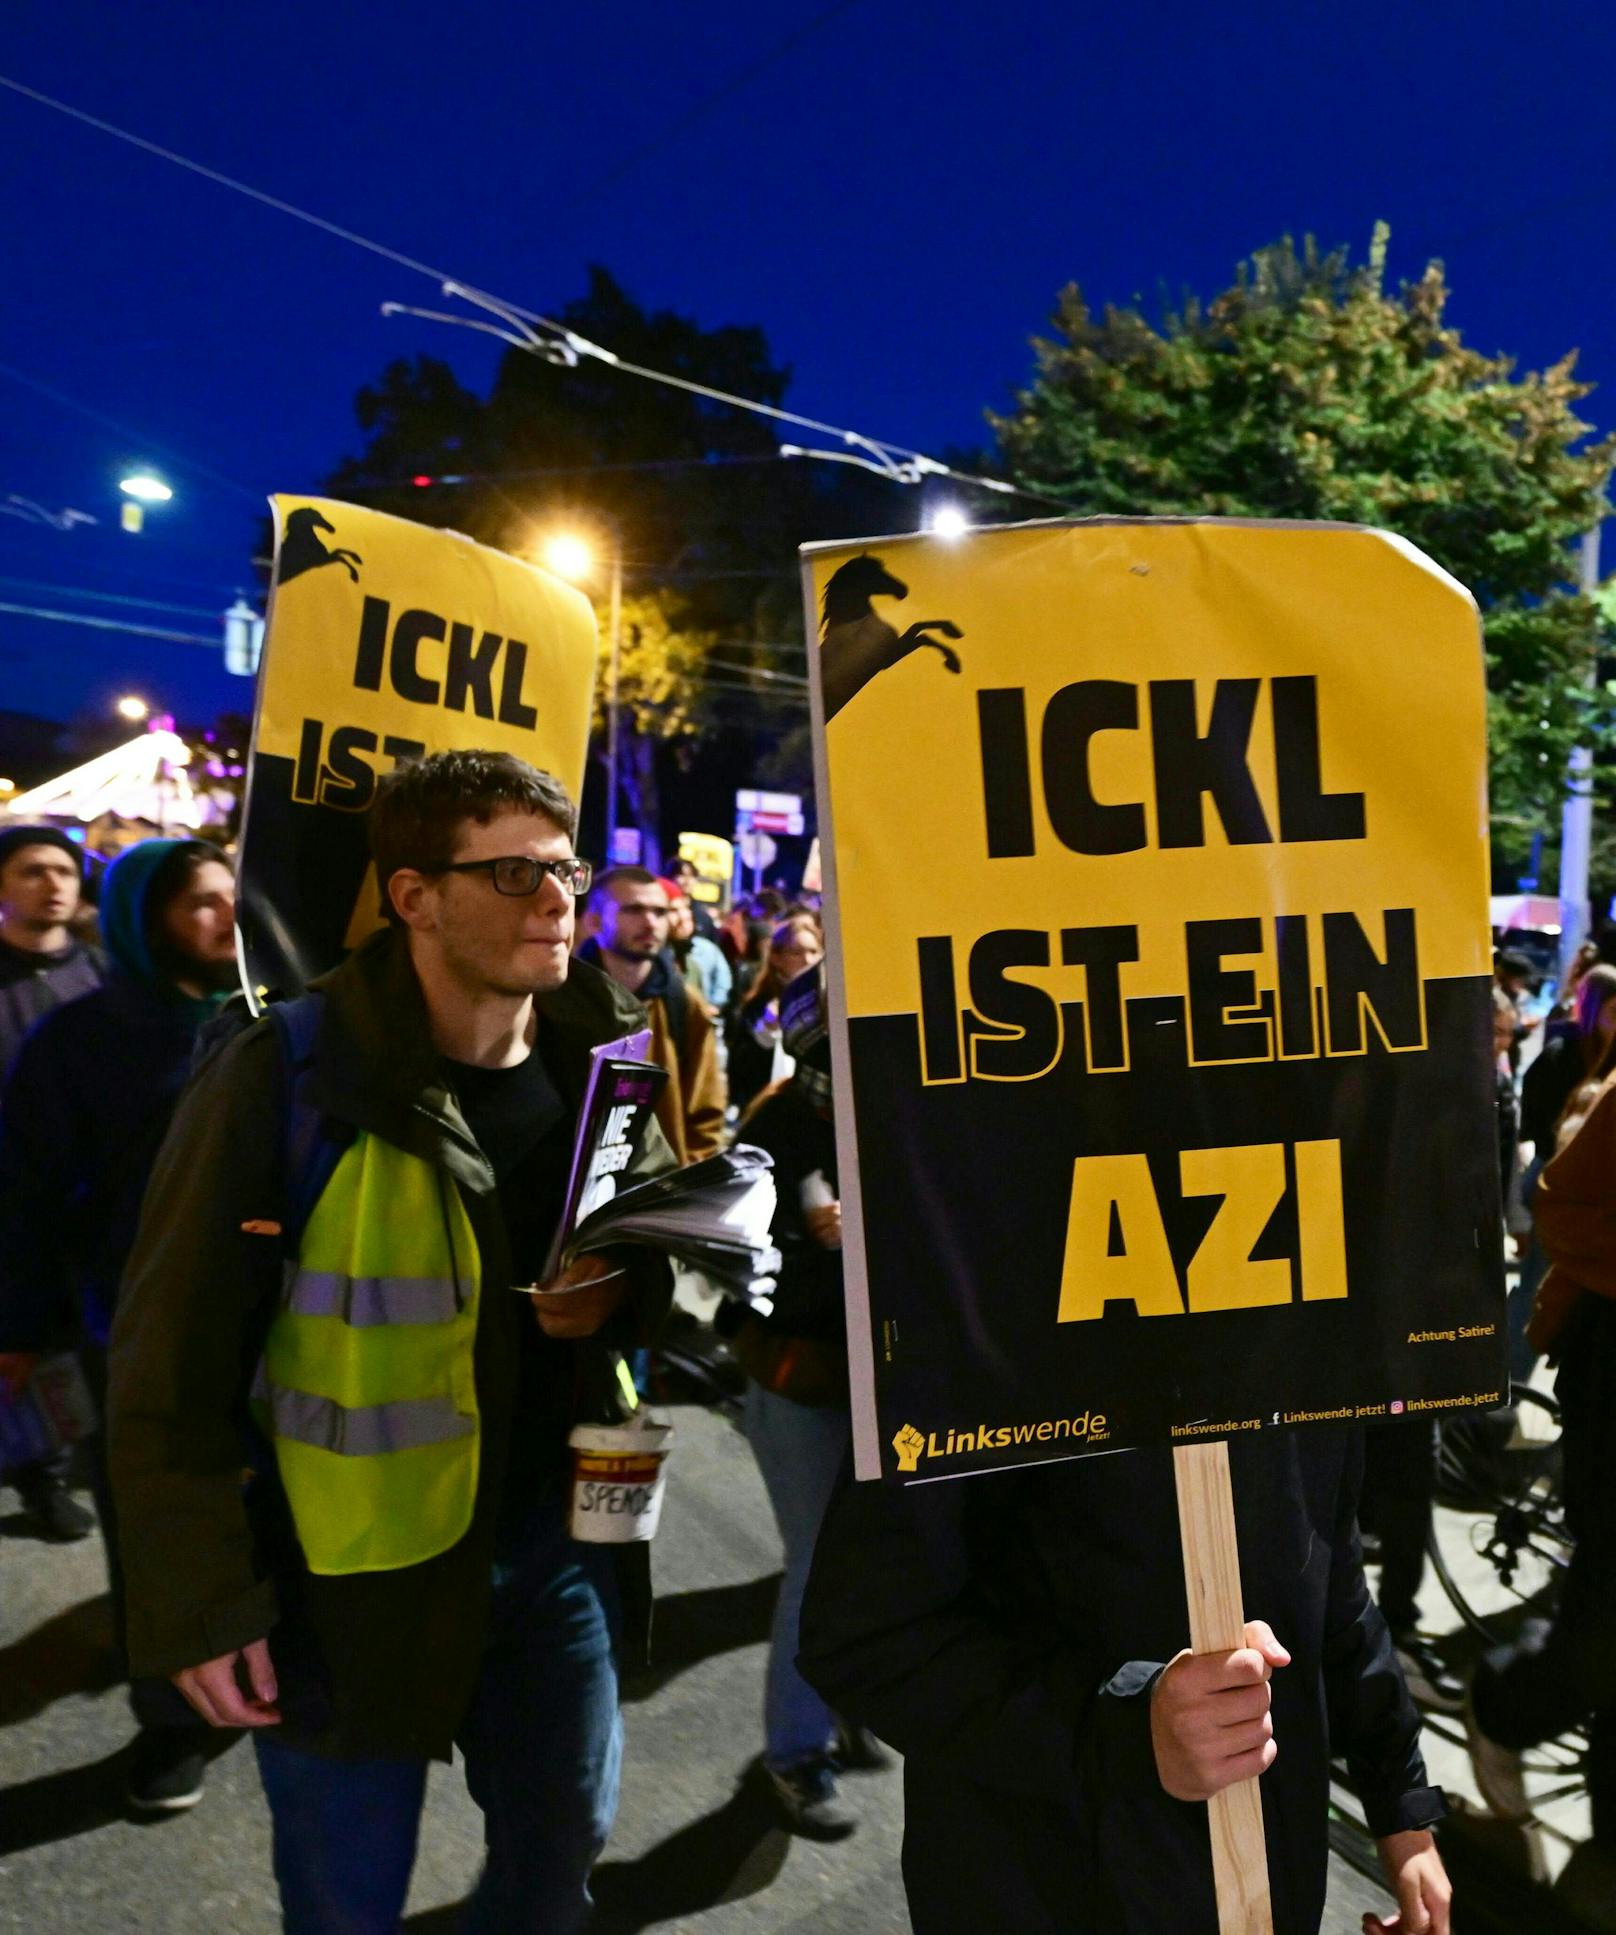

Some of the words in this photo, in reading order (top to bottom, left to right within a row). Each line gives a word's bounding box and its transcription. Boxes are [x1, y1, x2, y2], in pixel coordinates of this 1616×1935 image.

[354, 595, 538, 731] ICKL
[977, 675, 1367, 859] ICKL
[917, 924, 1139, 1086] IST
[1185, 908, 1428, 1067] EIN
[1057, 1138, 1348, 1323] AZI
[1407, 1330, 1456, 1343] Achtung
[1458, 1324, 1495, 1338] Satire!
[927, 1410, 1106, 1458] Linkswende
[1171, 1419, 1262, 1437] linkswende.org
[1283, 1407, 1353, 1423] Linkswende
[1355, 1404, 1386, 1418] jetzt!
[1407, 1392, 1499, 1411] linkswende.jetzt
